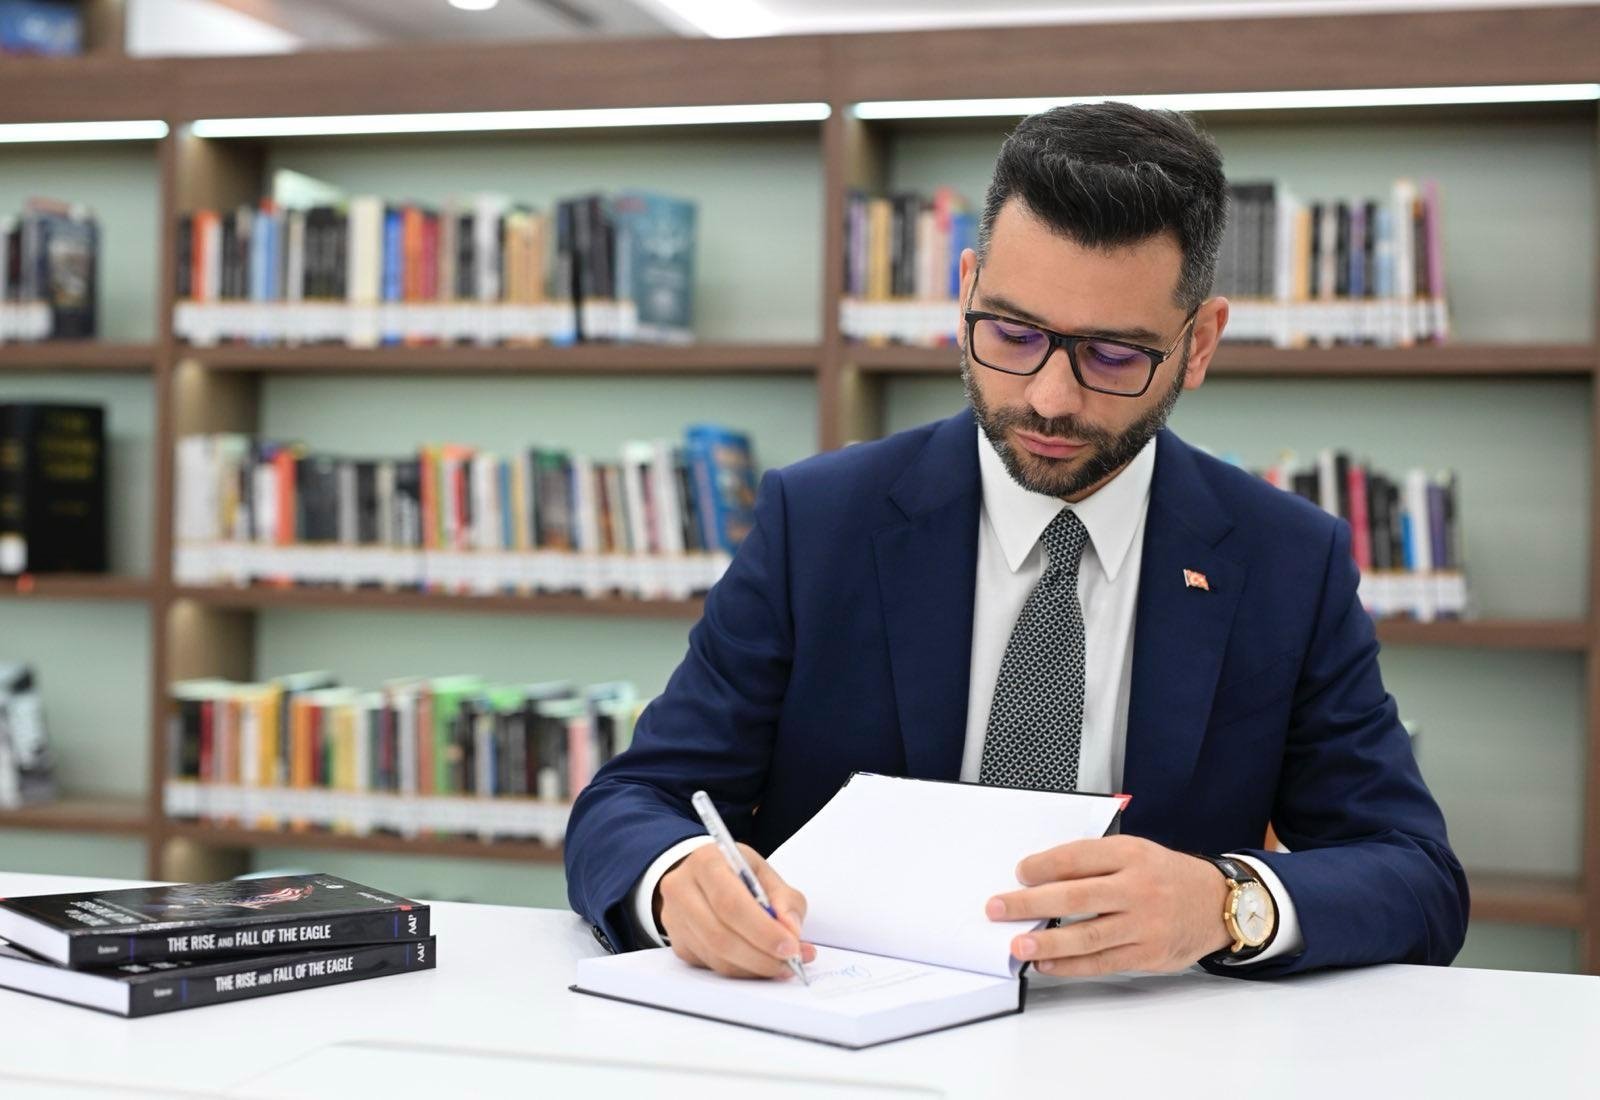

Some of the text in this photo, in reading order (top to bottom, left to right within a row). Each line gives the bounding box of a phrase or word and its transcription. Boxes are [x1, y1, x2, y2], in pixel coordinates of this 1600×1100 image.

[167, 925, 331, 952] THE RISE AND FALL OF THE EAGLE
[215, 956, 354, 992] THE RISE AND FALL OF THE EAGLE
